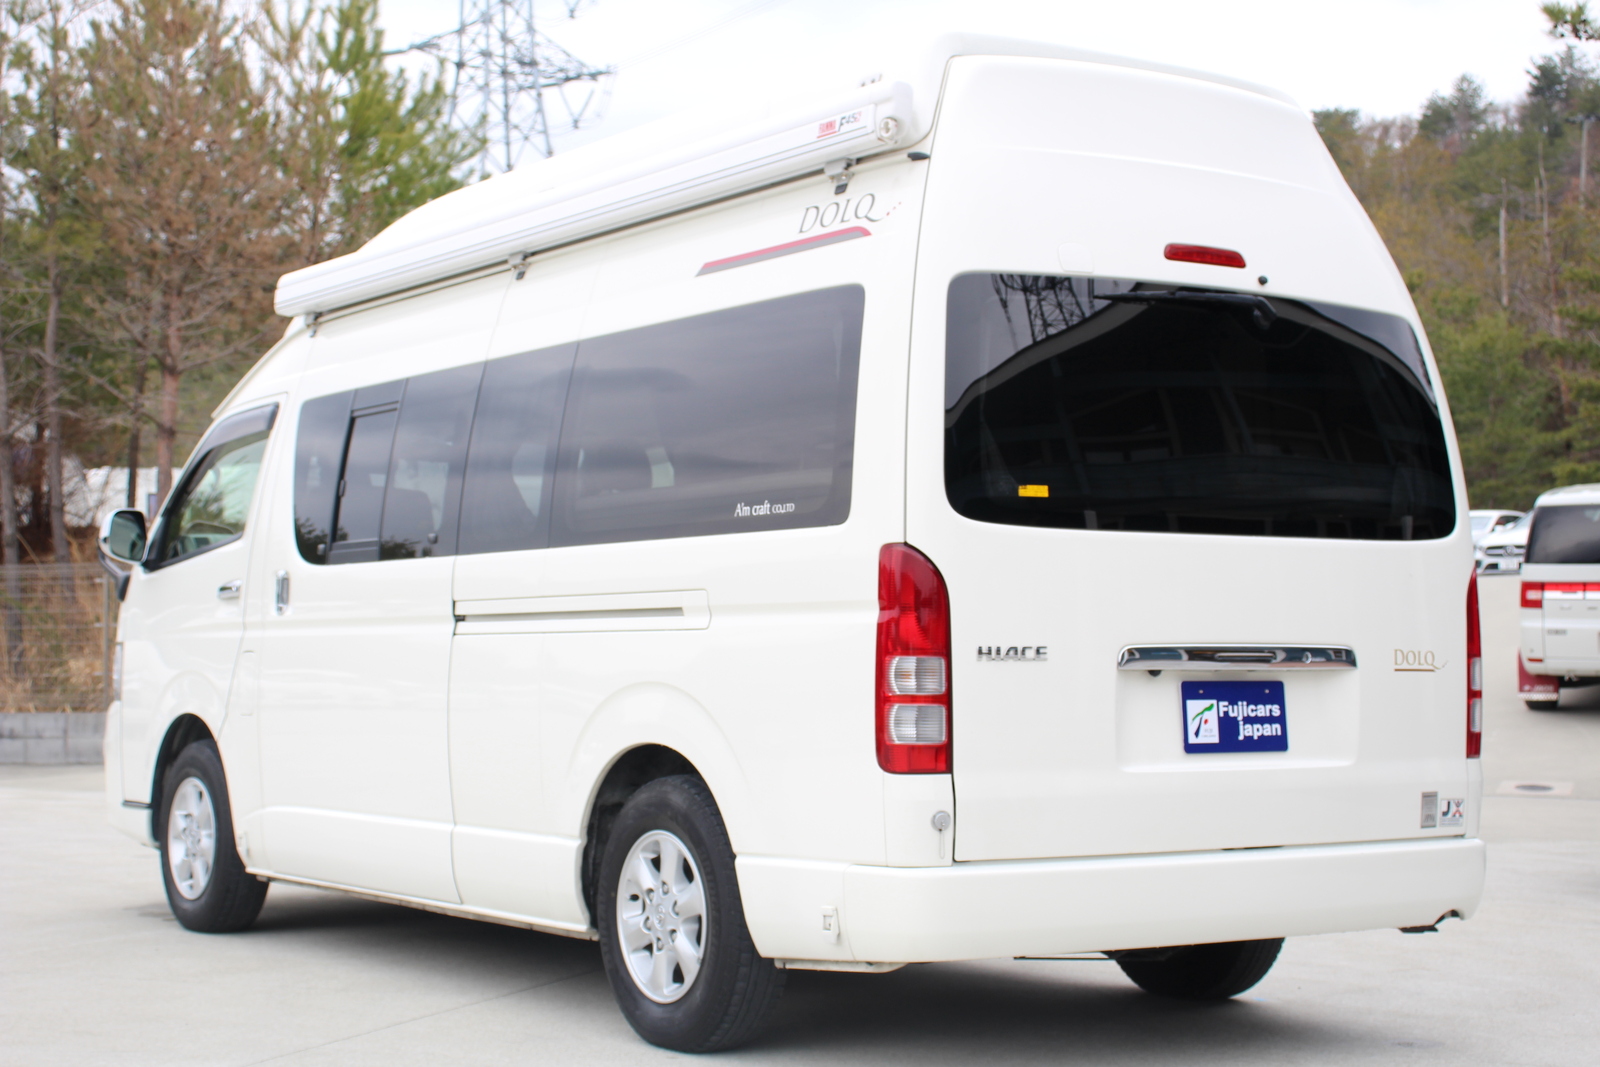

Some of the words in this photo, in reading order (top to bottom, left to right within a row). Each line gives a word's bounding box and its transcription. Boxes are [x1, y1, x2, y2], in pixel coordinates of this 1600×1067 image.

[798, 193, 883, 234] DOLQ
[752, 500, 771, 516] craft
[977, 646, 1048, 661] HIACE
[1394, 648, 1441, 670] DOLQ
[1218, 701, 1281, 721] Fujicars
[1238, 720, 1281, 740] japan
